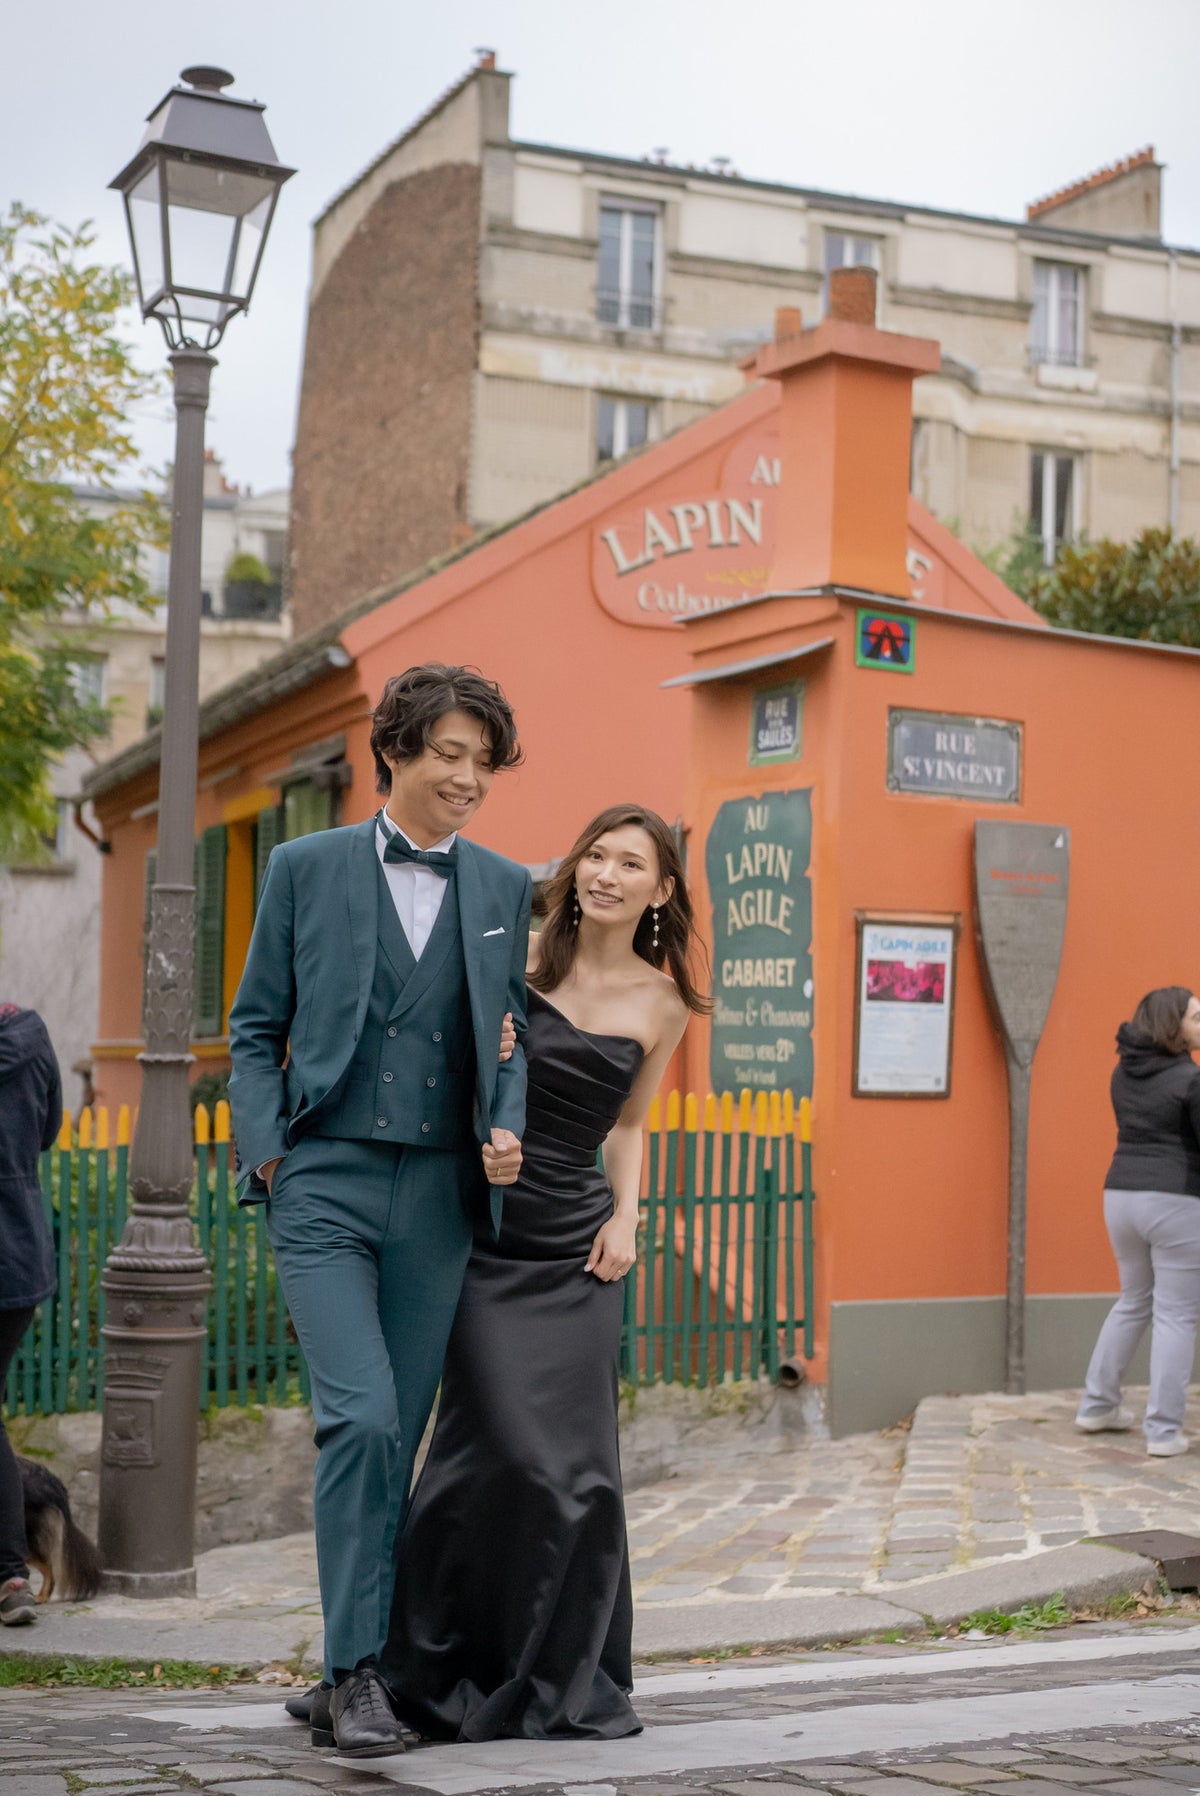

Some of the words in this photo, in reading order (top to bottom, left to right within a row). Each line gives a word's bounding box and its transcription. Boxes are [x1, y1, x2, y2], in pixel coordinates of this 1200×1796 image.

[602, 499, 763, 576] LAPIN
[765, 696, 788, 719] RUE
[936, 731, 976, 755] RUE
[923, 757, 1006, 787] VINCENT
[743, 804, 770, 834] AU
[725, 842, 793, 885] LAPIN
[727, 888, 795, 937] AGILE
[722, 957, 796, 988] CABARET
